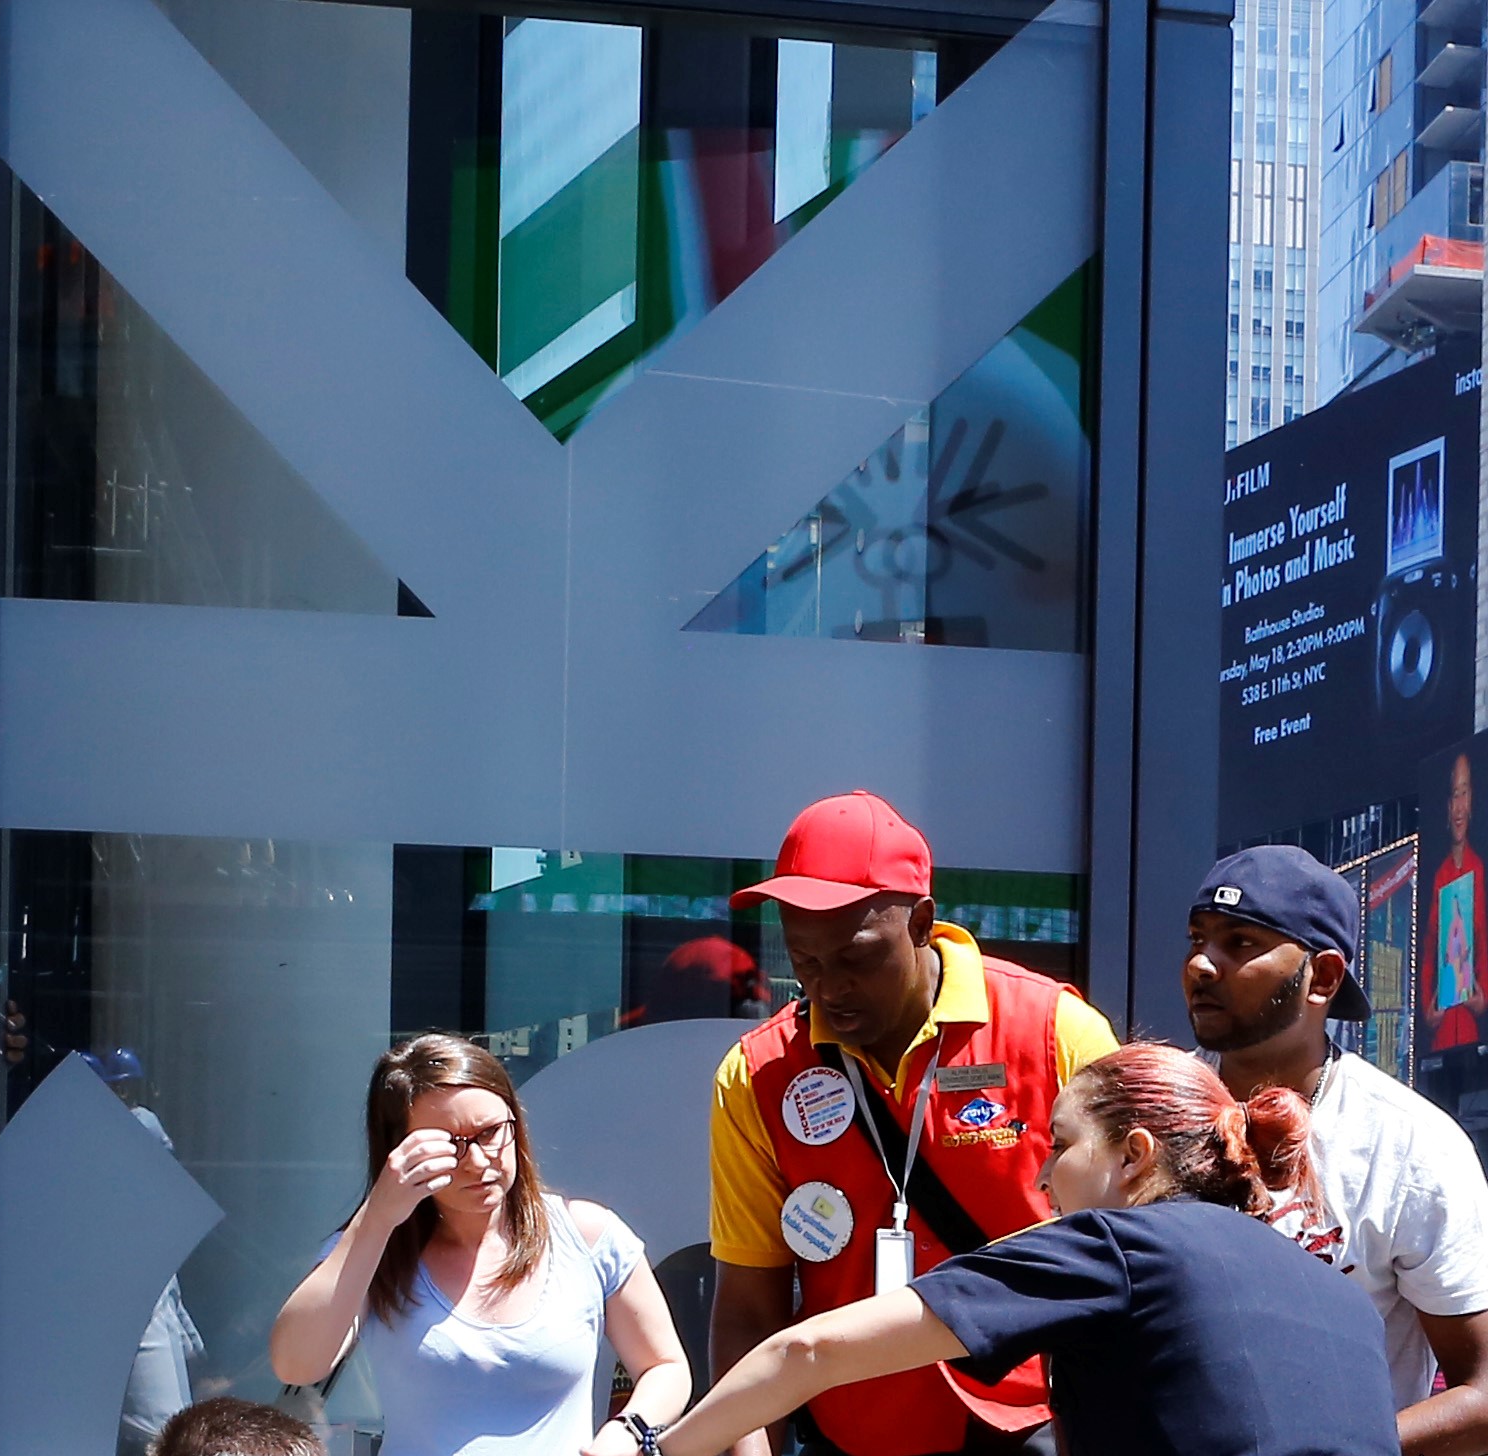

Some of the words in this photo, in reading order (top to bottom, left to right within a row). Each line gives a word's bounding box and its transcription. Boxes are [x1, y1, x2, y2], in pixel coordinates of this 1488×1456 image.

[1228, 520, 1285, 565] Immerse
[1289, 482, 1347, 539] Yourself
[1235, 564, 1280, 603] Photos
[1285, 541, 1310, 584] and
[1314, 528, 1356, 573] Music
[1244, 617, 1290, 644] Bathhouse
[1291, 602, 1325, 627] Studios
[1242, 684, 1261, 706] 538
[1271, 673, 1291, 696] 11th
[1304, 662, 1326, 686] NYC
[1250, 654, 1270, 673] May
[1254, 726, 1278, 745] Free
[1280, 712, 1311, 737] Event
[811, 1069, 844, 1080] ABOUT
[794, 1092, 811, 1138] TICKETS
